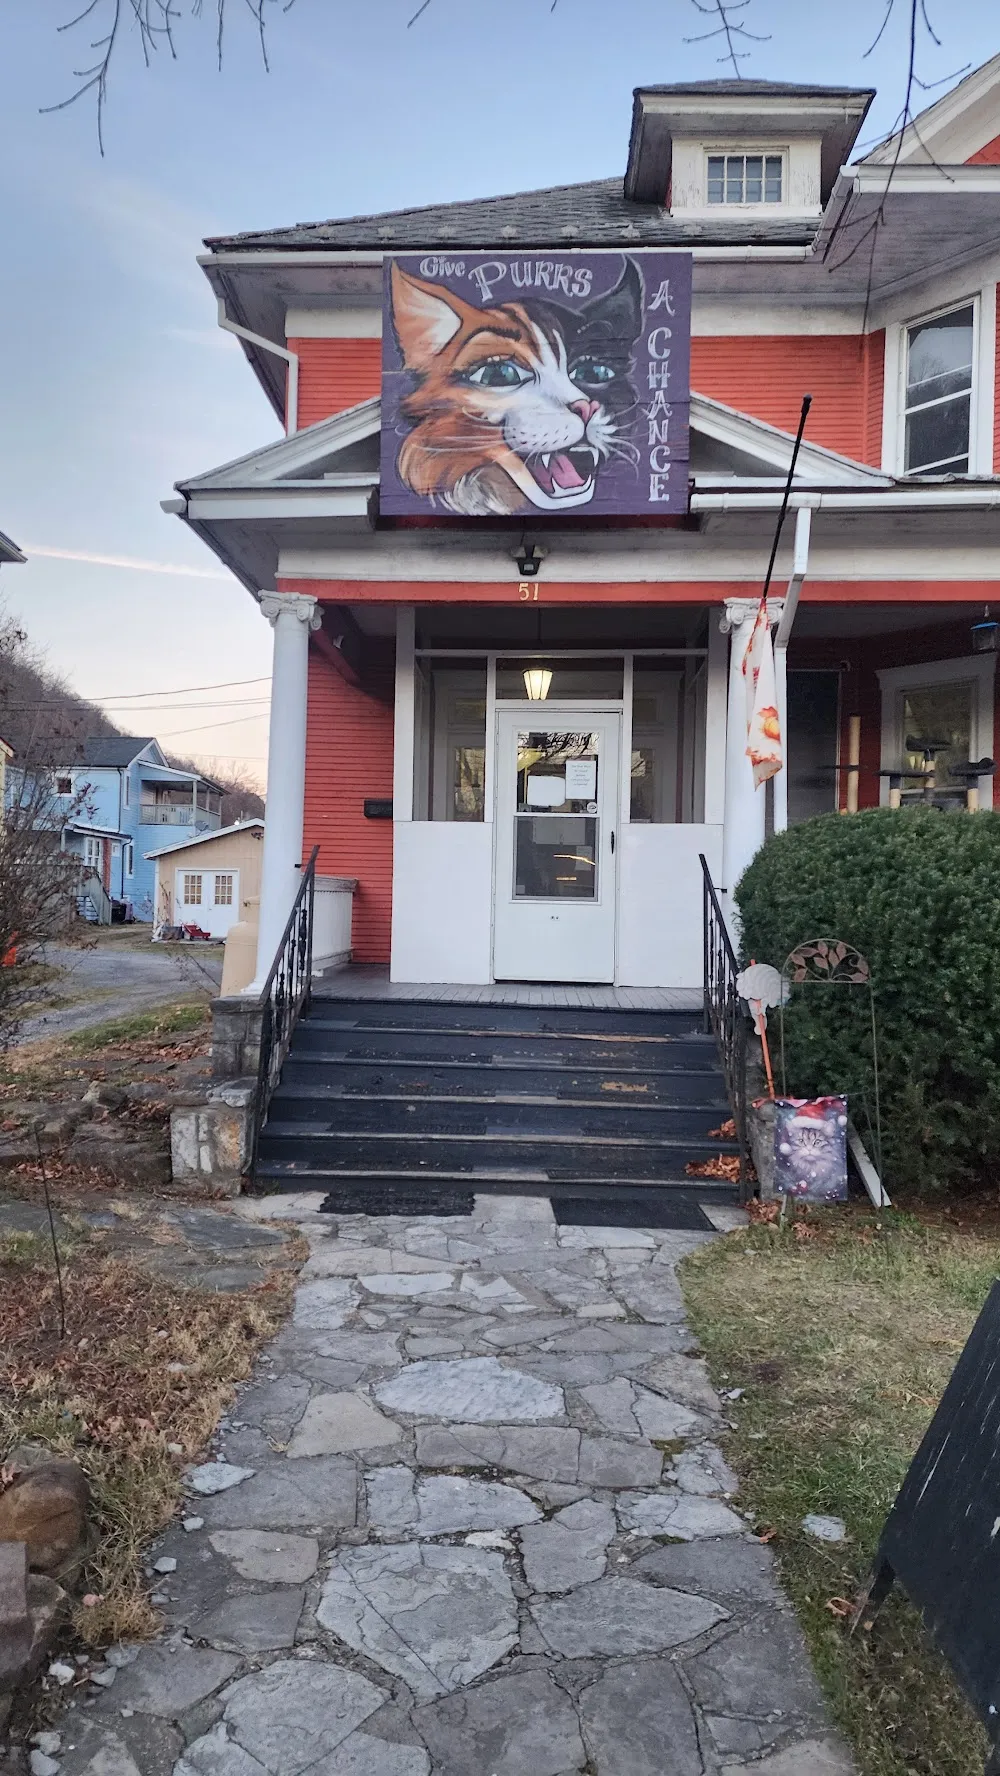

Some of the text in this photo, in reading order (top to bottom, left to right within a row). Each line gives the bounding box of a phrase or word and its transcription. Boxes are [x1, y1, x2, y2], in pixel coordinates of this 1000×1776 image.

[420, 256, 593, 302] Give PURRS
[646, 280, 675, 502] A CHANCE
[519, 582, 539, 601] 51
